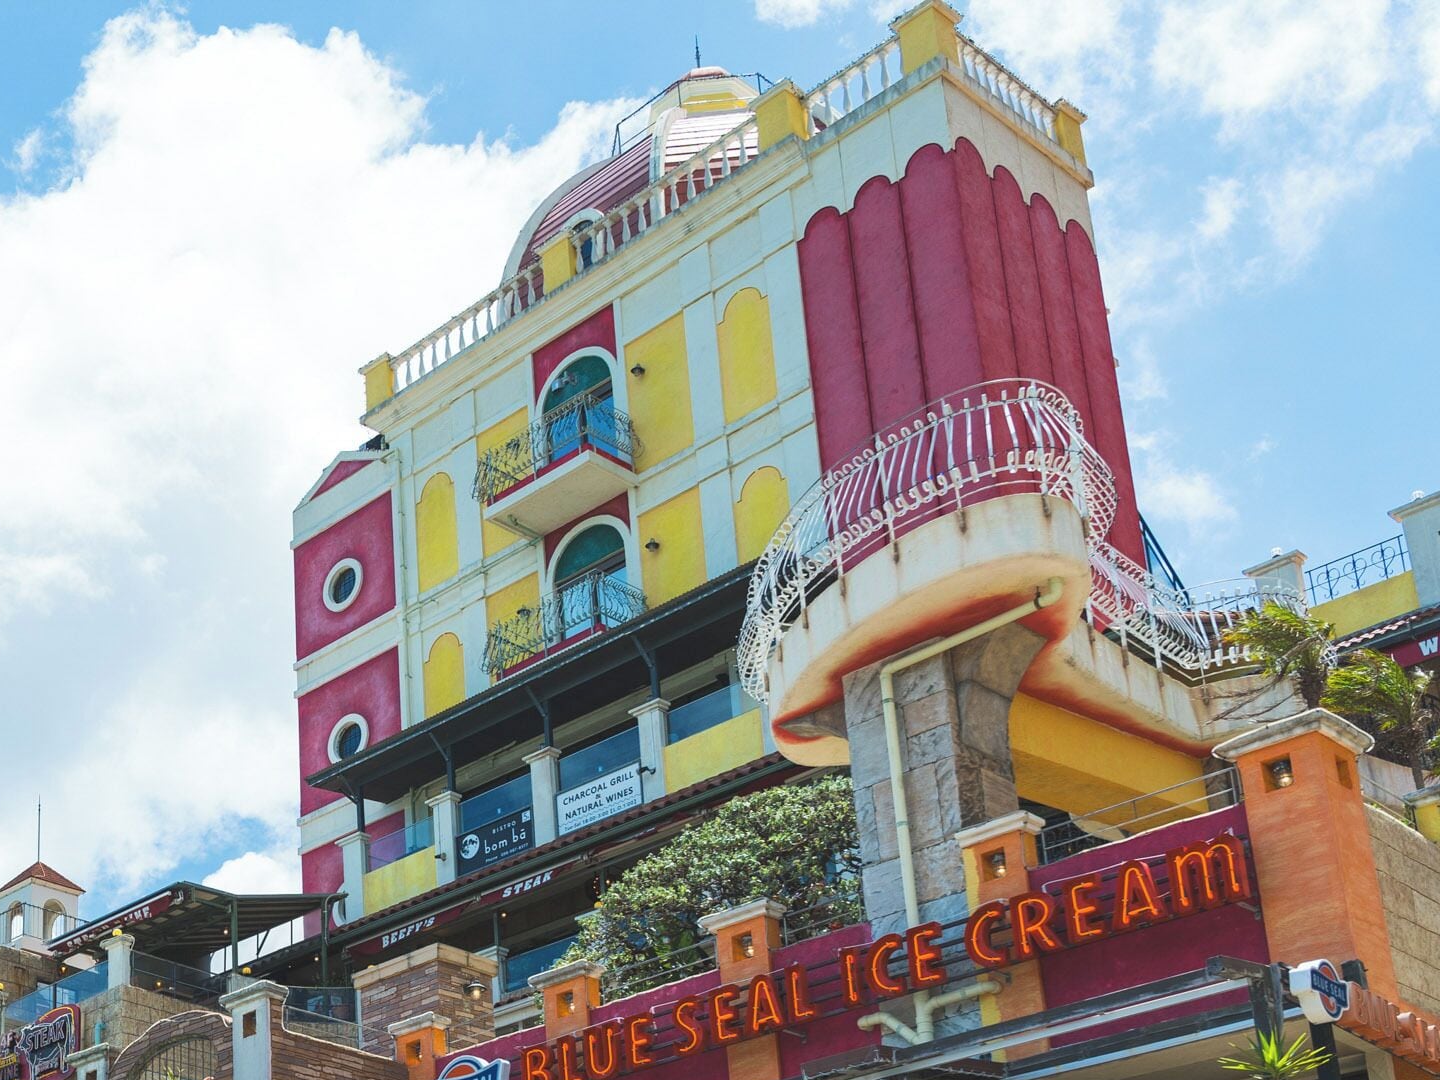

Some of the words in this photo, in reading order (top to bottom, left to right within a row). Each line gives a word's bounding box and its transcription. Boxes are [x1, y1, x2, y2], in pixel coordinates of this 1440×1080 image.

[562, 782, 608, 806] CHARCOAL
[609, 771, 634, 786] GRILL
[565, 799, 603, 820] NATURAL
[605, 786, 634, 803] WINES
[492, 820, 517, 834] BISTRO
[484, 839, 508, 854] bom
[502, 871, 553, 898] STEAK
[381, 916, 436, 949] BEEFY'S
[672, 961, 818, 1057] SEAL
[837, 921, 945, 1005] ICE
[964, 836, 1250, 969] CREAM
[1312, 973, 1330, 993] BLUE
[1329, 981, 1346, 1004] SEAL
[25, 1019, 65, 1052] STEAK
